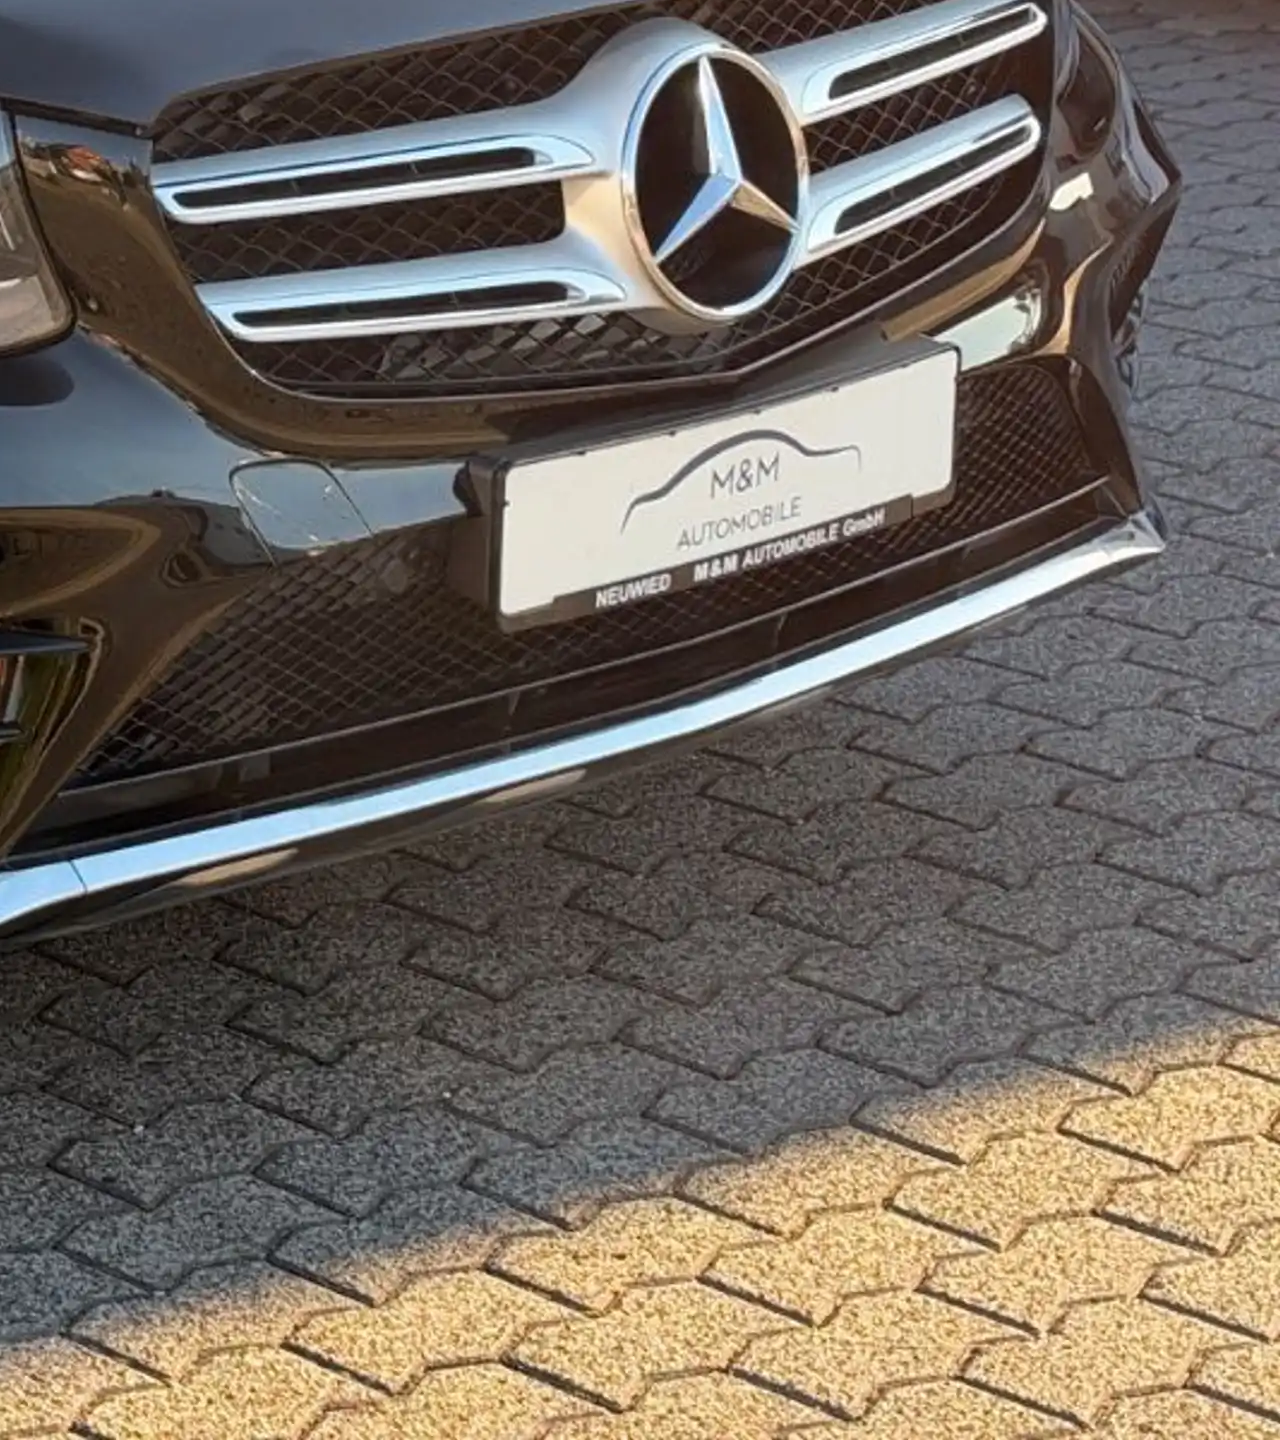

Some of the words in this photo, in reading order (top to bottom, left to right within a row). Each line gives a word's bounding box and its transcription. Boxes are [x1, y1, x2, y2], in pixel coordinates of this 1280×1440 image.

[710, 450, 779, 499] M&M
[677, 496, 801, 551] AUTOMOBILE
[595, 573, 672, 608] NEUWIED
[693, 553, 738, 582] M&M
[741, 522, 841, 570] AUTOMOBILE
[842, 508, 886, 537] GmbH
